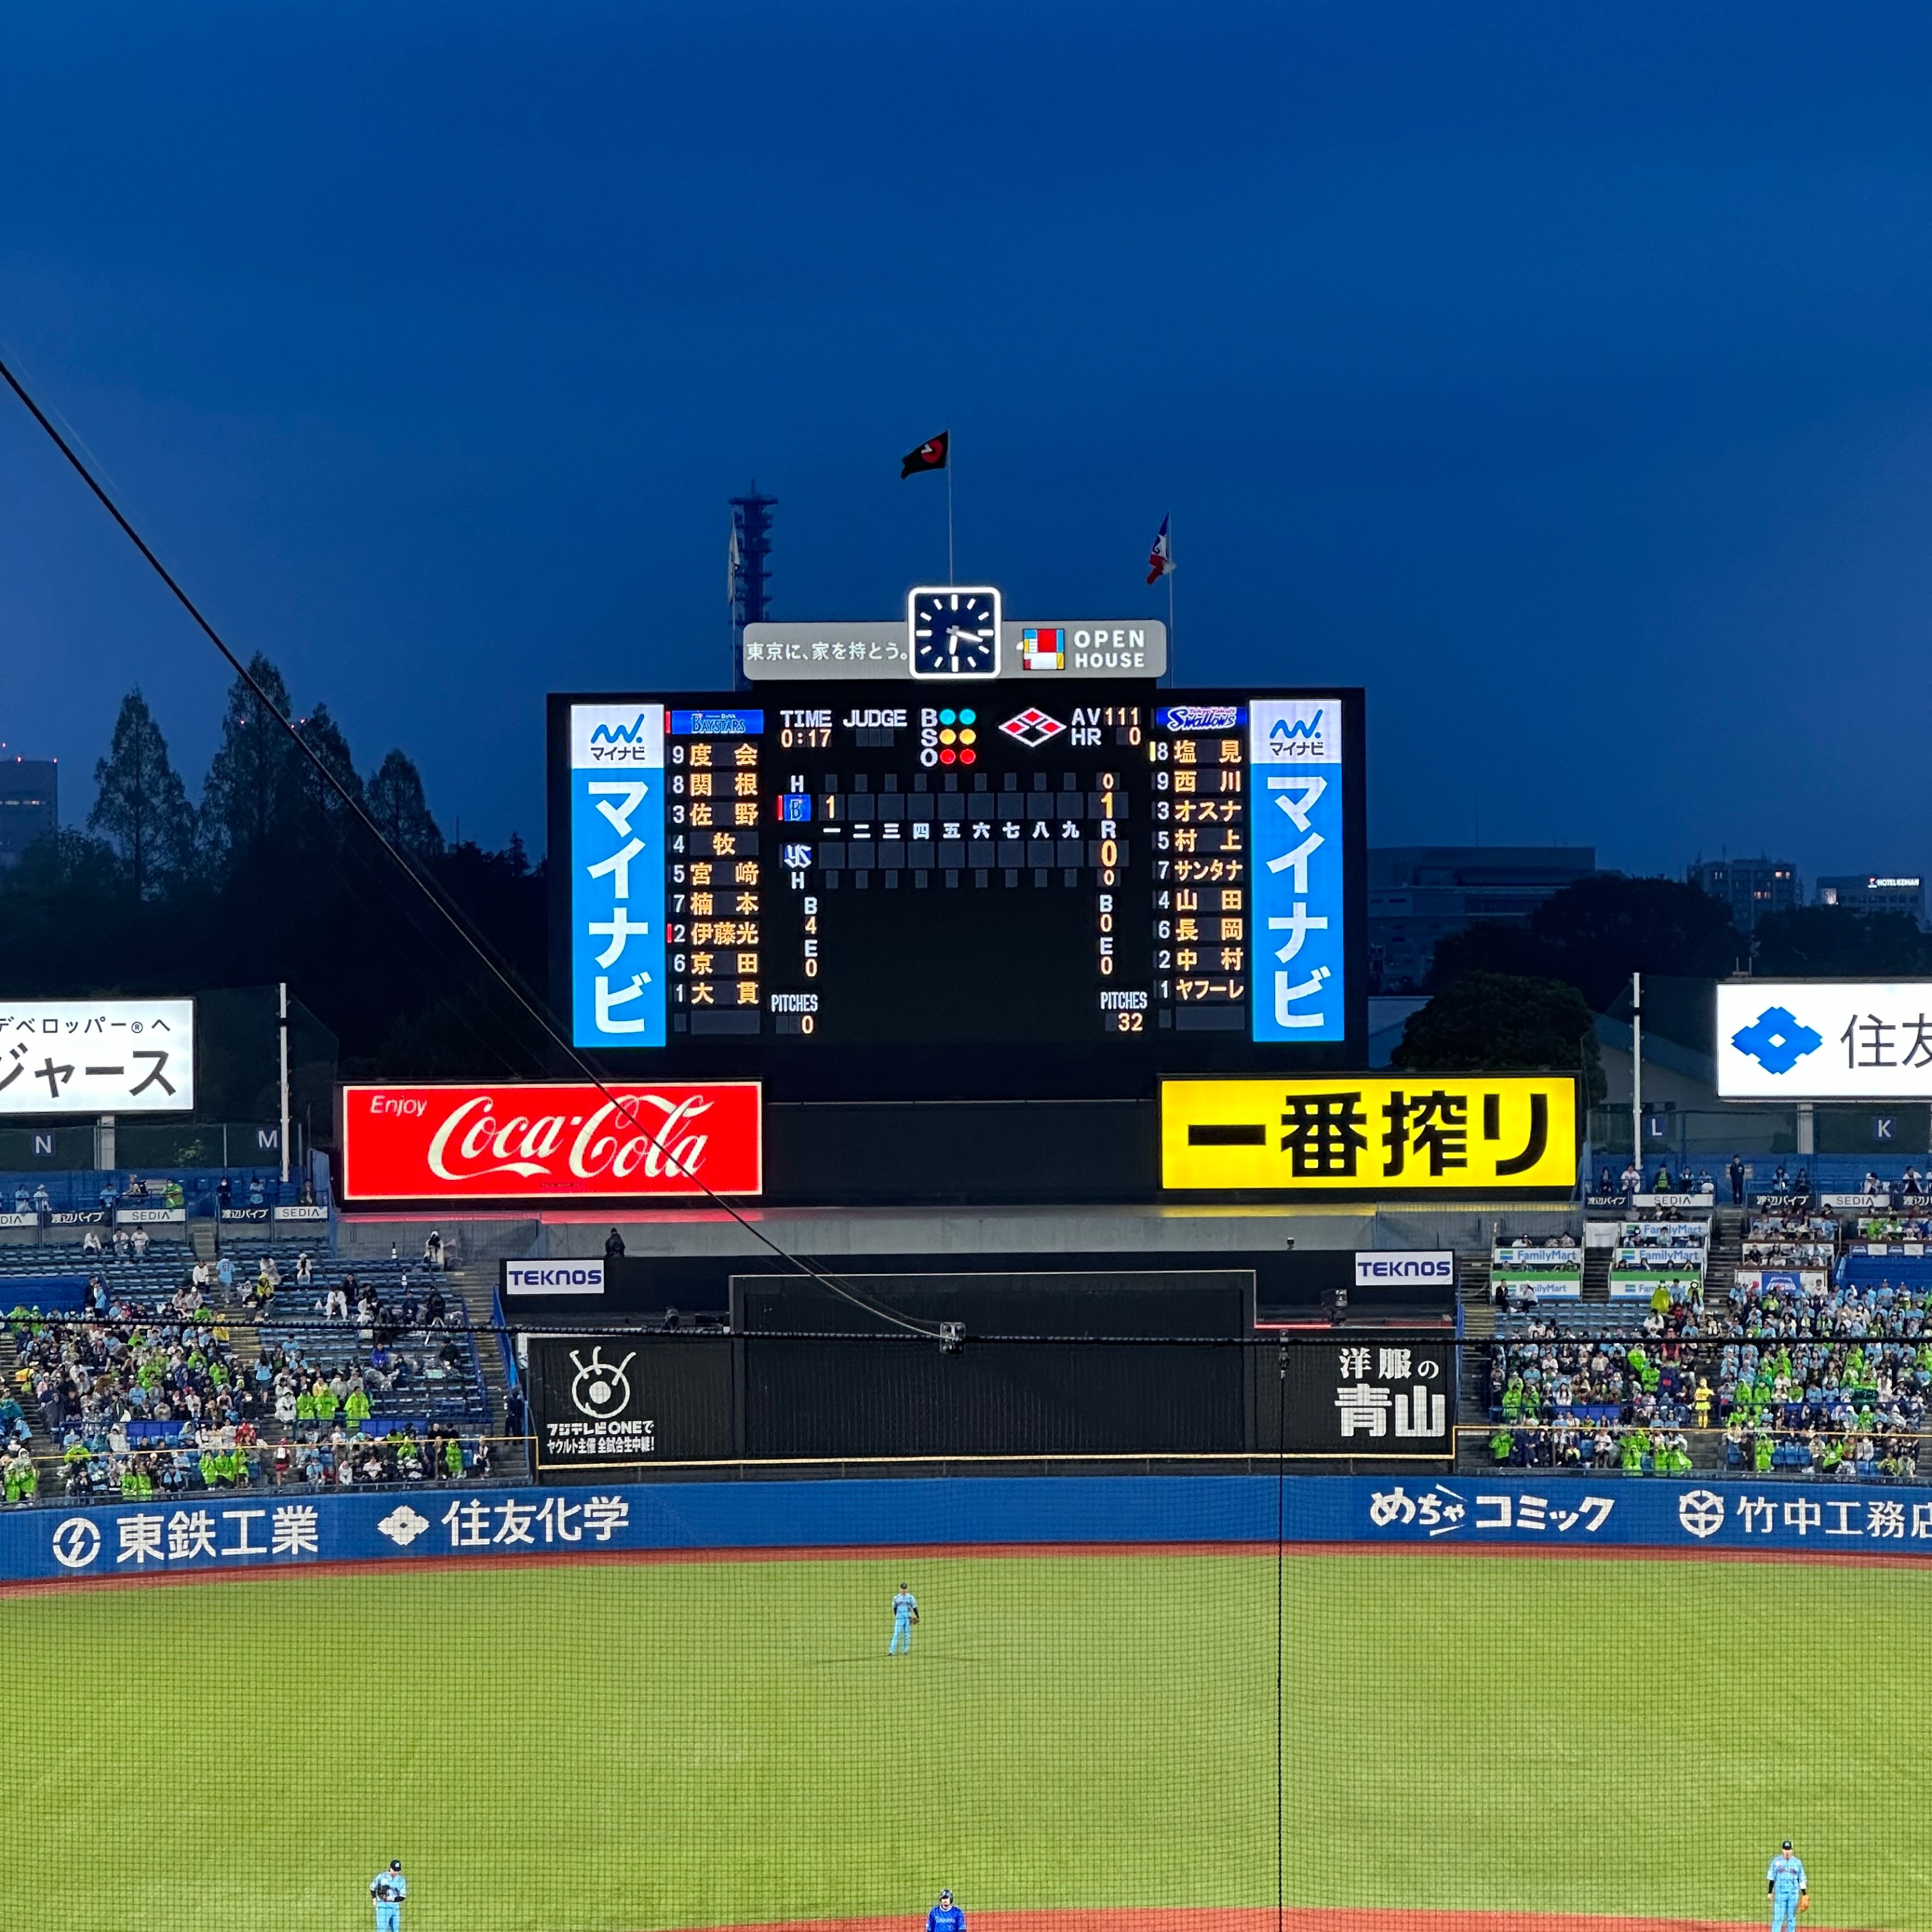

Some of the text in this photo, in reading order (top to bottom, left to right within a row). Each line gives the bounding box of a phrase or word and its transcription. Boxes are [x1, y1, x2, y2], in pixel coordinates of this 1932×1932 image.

[1075, 631, 1143, 647] OPEN
[746, 641, 908, 661] 東京に、家を持とう。
[1076, 653, 1144, 667] HOUSE
[691, 713, 746, 733] BAYSTARS
[780, 709, 907, 727] TIME JUDGE
[922, 708, 937, 727] B
[1071, 708, 1137, 726] AV 111
[1167, 706, 1236, 731] Swallows
[782, 729, 830, 747] 0:17
[921, 729, 938, 747] S
[1071, 728, 1140, 745] HR 0
[591, 747, 645, 760] マイナビ
[673, 743, 757, 766] 9 度会
[920, 749, 938, 766] O
[1157, 740, 1241, 763] 8 塩見
[1270, 742, 1324, 755] マイナビ
[673, 773, 757, 796] 8 関根
[791, 775, 804, 792] H
[1103, 773, 1113, 789] 0
[1158, 771, 1240, 792] 9 西川
[826, 796, 834, 818] 1
[1102, 792, 1112, 818] 1
[1158, 800, 1241, 822] 3 オスナ
[673, 803, 758, 826] 3 佐野
[853, 824, 870, 838] 二
[883, 823, 900, 839] 三
[914, 823, 929, 839] 四
[943, 823, 961, 838] 五
[973, 822, 990, 839] 六
[1002, 822, 1020, 839] 七
[1032, 822, 1049, 838] 八
[1062, 821, 1079, 838] 九
[1102, 820, 1116, 839] R
[674, 833, 735, 855] 4 牧
[1158, 829, 1242, 852] 5 村上
[1102, 841, 1116, 866] 0
[674, 865, 684, 882] 5
[1104, 870, 1114, 885] 0
[1159, 859, 1242, 881] 7 サンタナ
[792, 871, 804, 890] H
[1877, 878, 1896, 886] HOTEL
[588, 782, 651, 1032] マイナビ
[674, 892, 758, 915] 7 楠本
[804, 897, 817, 914] B
[1100, 895, 1112, 912] B
[1159, 889, 1241, 911] 4 山田
[1267, 777, 1330, 1027] マイナビ
[805, 916, 816, 934] 4
[1100, 914, 1112, 932] 0
[1159, 918, 1242, 941] 6 長岡
[674, 922, 759, 945] 2 伊藤光
[805, 940, 817, 957] E
[1100, 937, 1113, 955] E
[674, 952, 757, 975] 6 京田
[806, 959, 817, 976] 0
[1101, 957, 1112, 974] 0
[1159, 947, 1243, 971] 2 中村
[676, 981, 758, 1004] 1 大貫
[1161, 979, 1243, 1000] 1 ヤフーレ
[771, 994, 818, 1012] PITCHES
[1101, 991, 1147, 1010] PITCHES
[802, 1016, 813, 1033] 0
[1119, 1013, 1142, 1031] 32
[371, 1095, 427, 1116] Enjoy
[1189, 1091, 1547, 1177] 一番搾り
[1652, 1119, 1662, 1135] L
[1879, 1120, 1890, 1137] K
[36, 1136, 51, 1153] N
[259, 1131, 276, 1147] M
[1654, 1196, 1691, 1205] SEDIA
[1836, 1196, 1874, 1205] SEDIA
[132, 1210, 170, 1221] SEDIA
[282, 1208, 319, 1218] SEDIA
[1517, 1249, 1576, 1262] FamilyMart
[508, 1270, 601, 1285] TEKNOS
[1358, 1262, 1450, 1277] TEKNOS
[1339, 1348, 1438, 1379] 洋服の
[1335, 1384, 1445, 1436] 青山
[547, 1421, 654, 1436] フジテレビONEで
[1370, 1487, 1615, 1532] めちゃコミック
[441, 1497, 628, 1546] 住友化学
[117, 1505, 318, 1562] 東鉄工業
